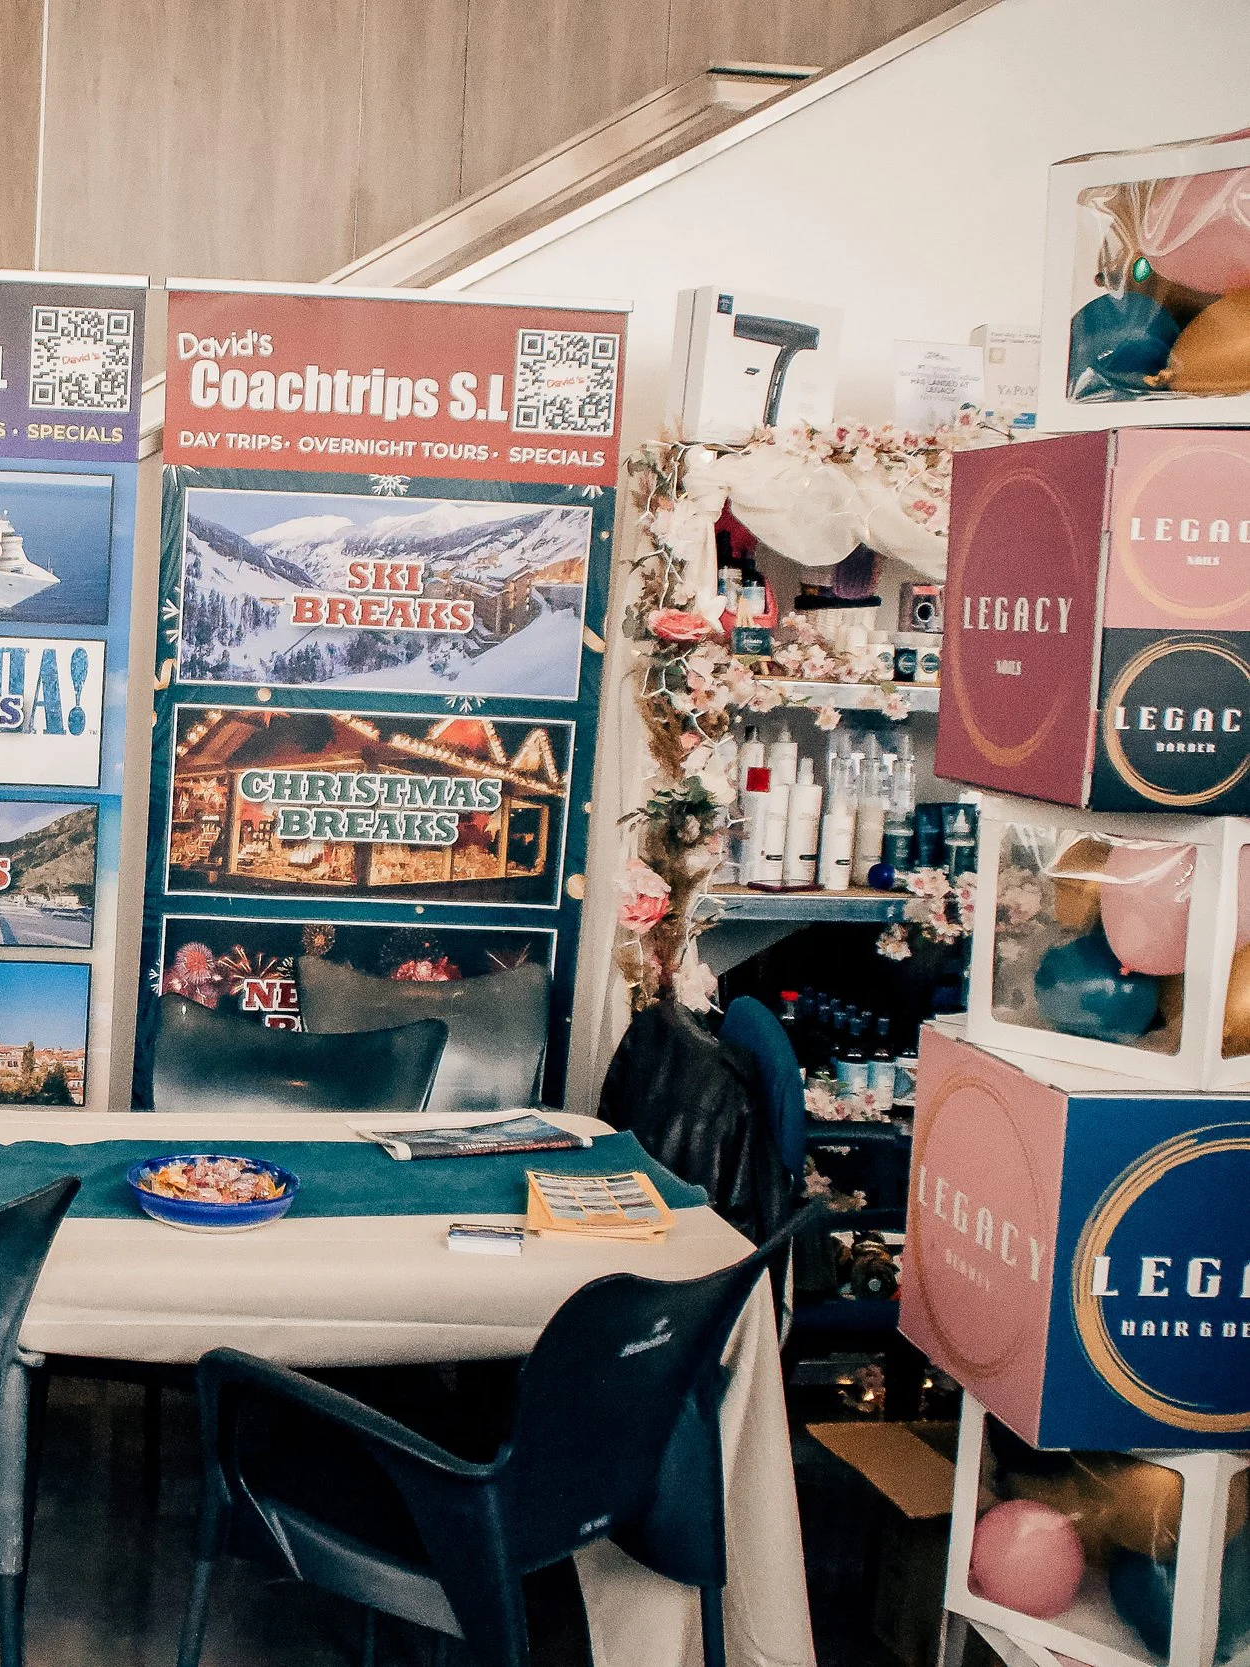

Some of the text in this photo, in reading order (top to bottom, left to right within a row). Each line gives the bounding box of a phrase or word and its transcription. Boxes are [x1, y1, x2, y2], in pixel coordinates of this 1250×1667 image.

[177, 330, 274, 360] David's
[190, 359, 508, 422] Coachtrips S.L
[27, 423, 124, 443] SPECIALS
[179, 430, 605, 467] DAY TRIPS OVERNIGHT TOURS SPECIALS
[348, 562, 424, 594] SKI
[291, 595, 474, 631] BREAKS
[963, 596, 1072, 634] LEGACY
[1114, 706, 1243, 733] LEGAC
[239, 771, 502, 810] CHRISTMAS
[278, 808, 458, 843] BREAKS
[918, 1165, 1047, 1282] LEGACY
[1091, 1256, 1250, 1298] LEG
[1121, 1319, 1189, 1337] HAIR
